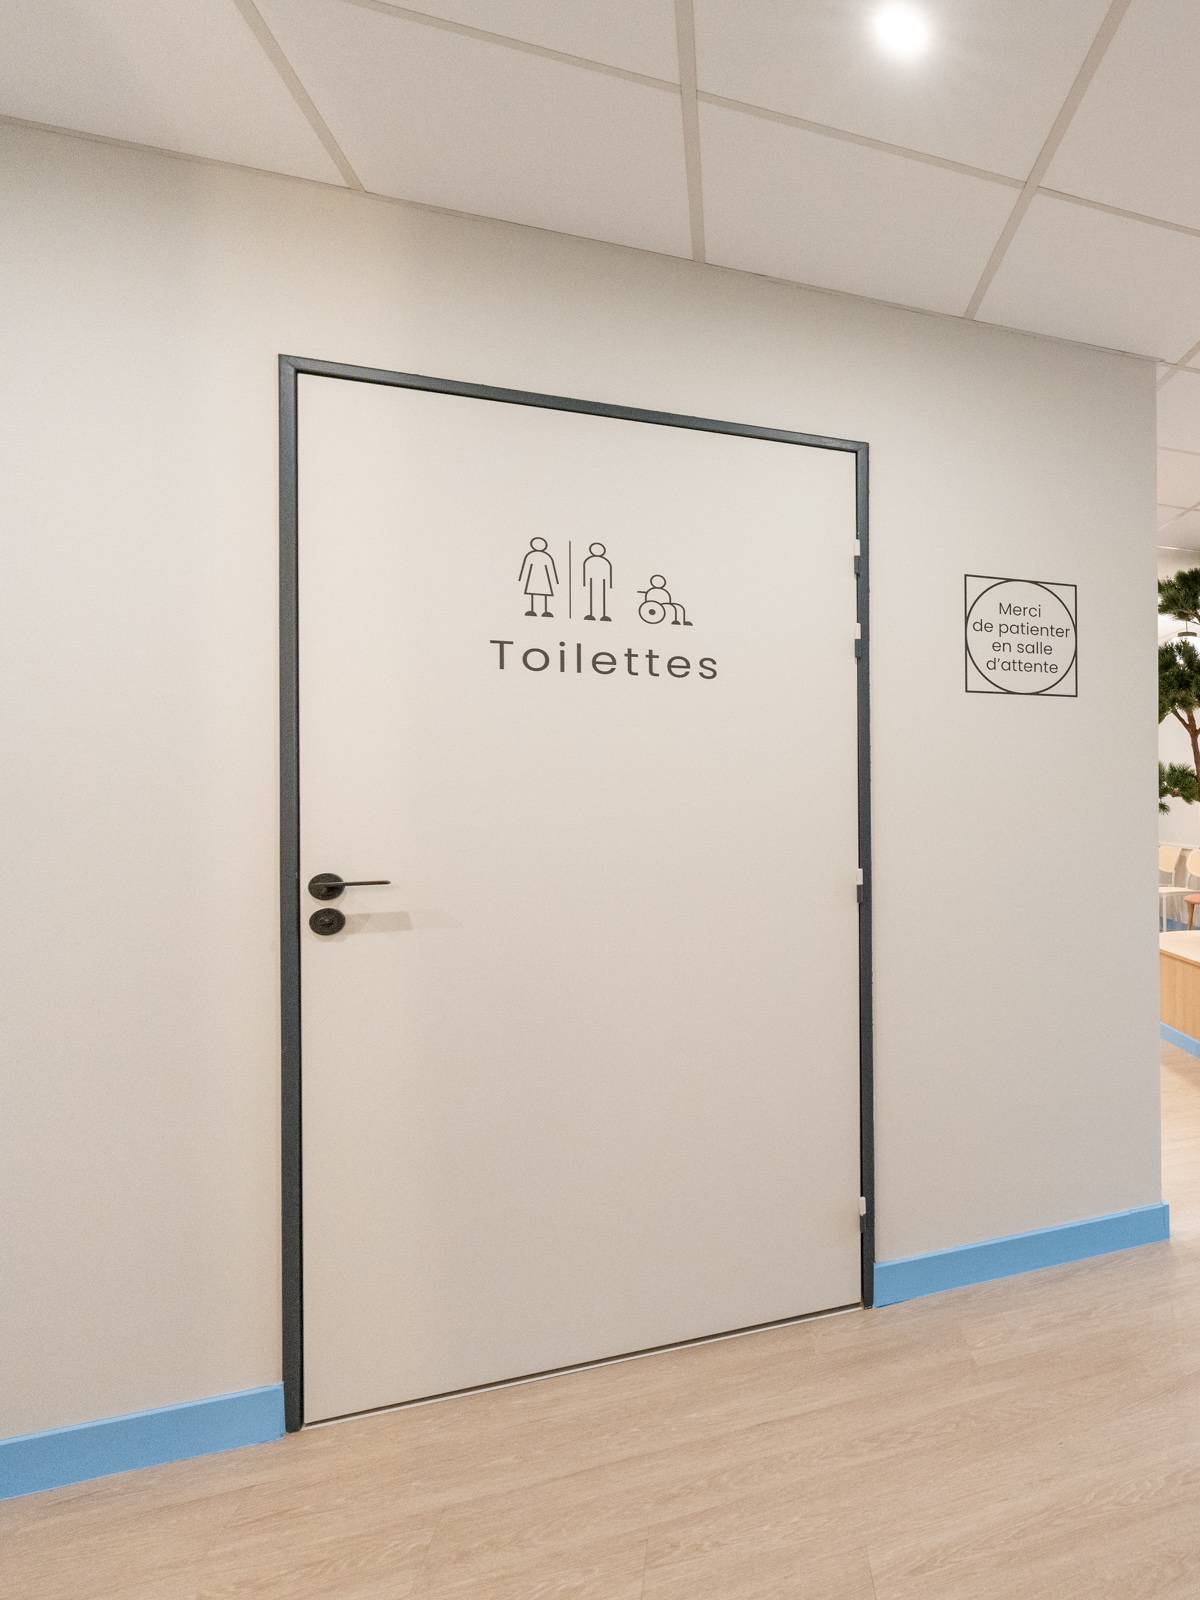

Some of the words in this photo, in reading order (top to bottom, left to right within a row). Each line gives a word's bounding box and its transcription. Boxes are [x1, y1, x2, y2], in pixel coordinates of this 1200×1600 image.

[999, 602, 1041, 617] Merci
[973, 619, 994, 632] de
[999, 622, 1071, 638] patienter
[992, 641, 1012, 652] en
[1017, 642, 1053, 655] salle
[489, 639, 718, 680] Toilettes
